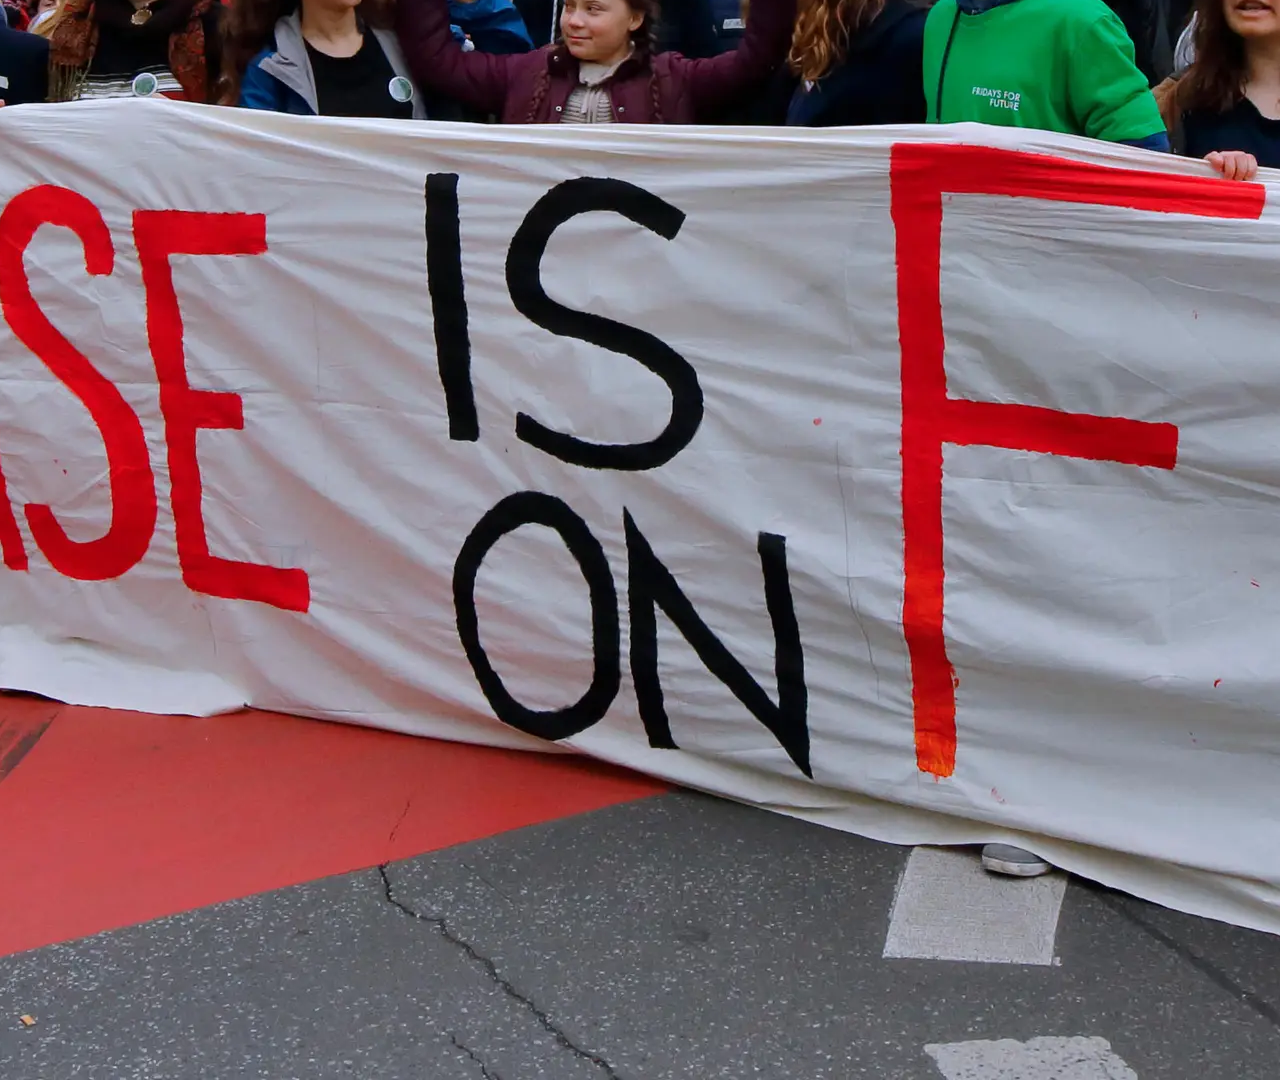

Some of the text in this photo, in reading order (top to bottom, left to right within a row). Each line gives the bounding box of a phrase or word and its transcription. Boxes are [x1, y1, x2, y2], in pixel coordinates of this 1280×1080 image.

[972, 86, 1020, 102] FRIDAYS FOR
[989, 98, 1020, 111] FUTURE
[425, 172, 704, 471] IS
[452, 490, 813, 780] ON
